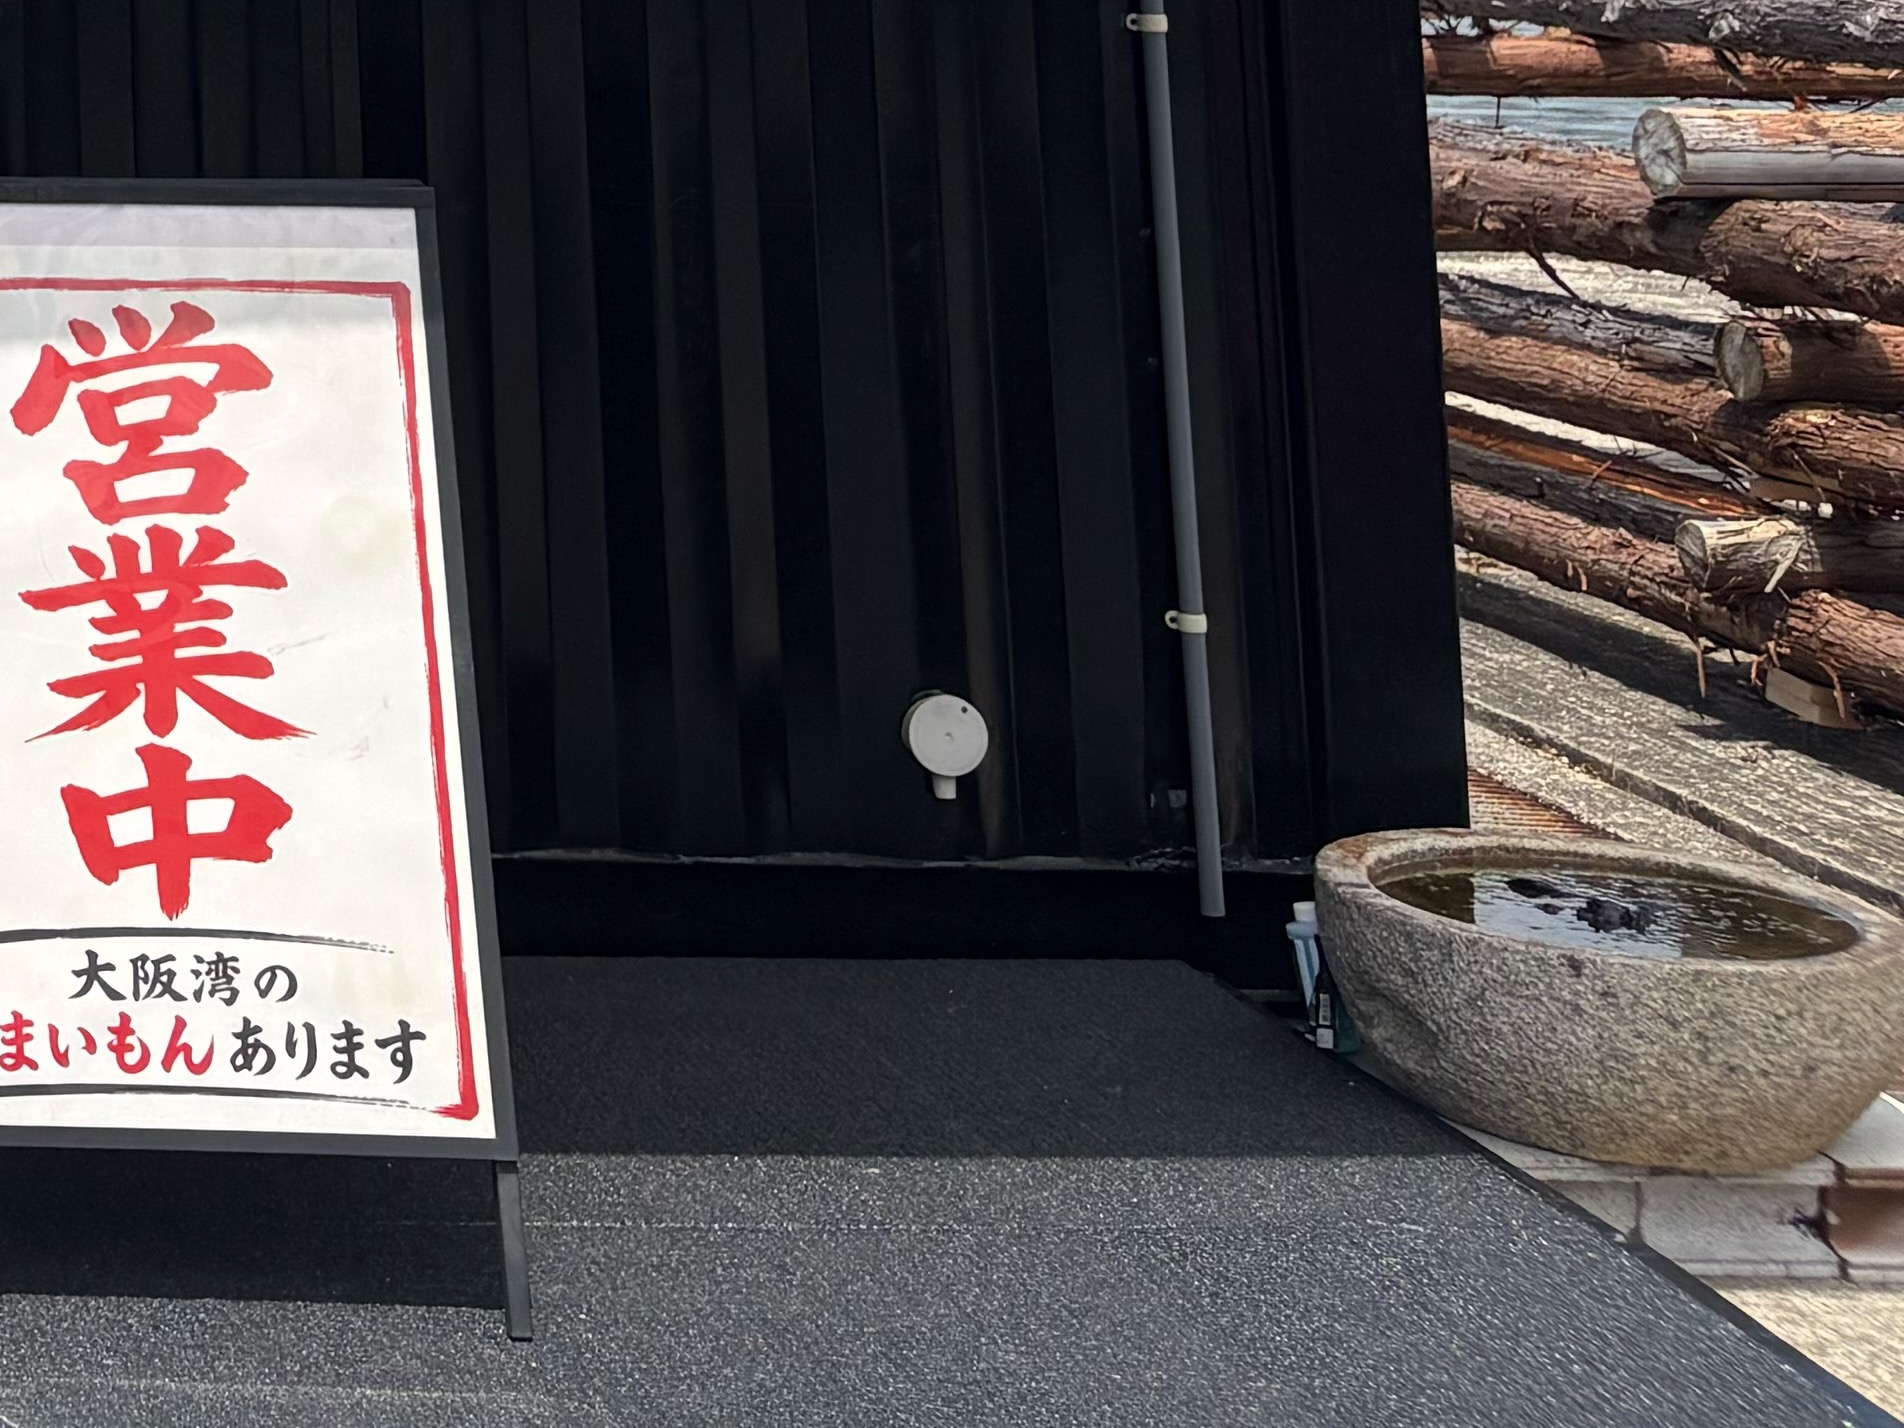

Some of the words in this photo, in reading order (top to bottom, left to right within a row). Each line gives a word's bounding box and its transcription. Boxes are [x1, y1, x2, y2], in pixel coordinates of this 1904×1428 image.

[9, 301, 315, 921] 営業中
[69, 948, 299, 1008] 大阪湾の
